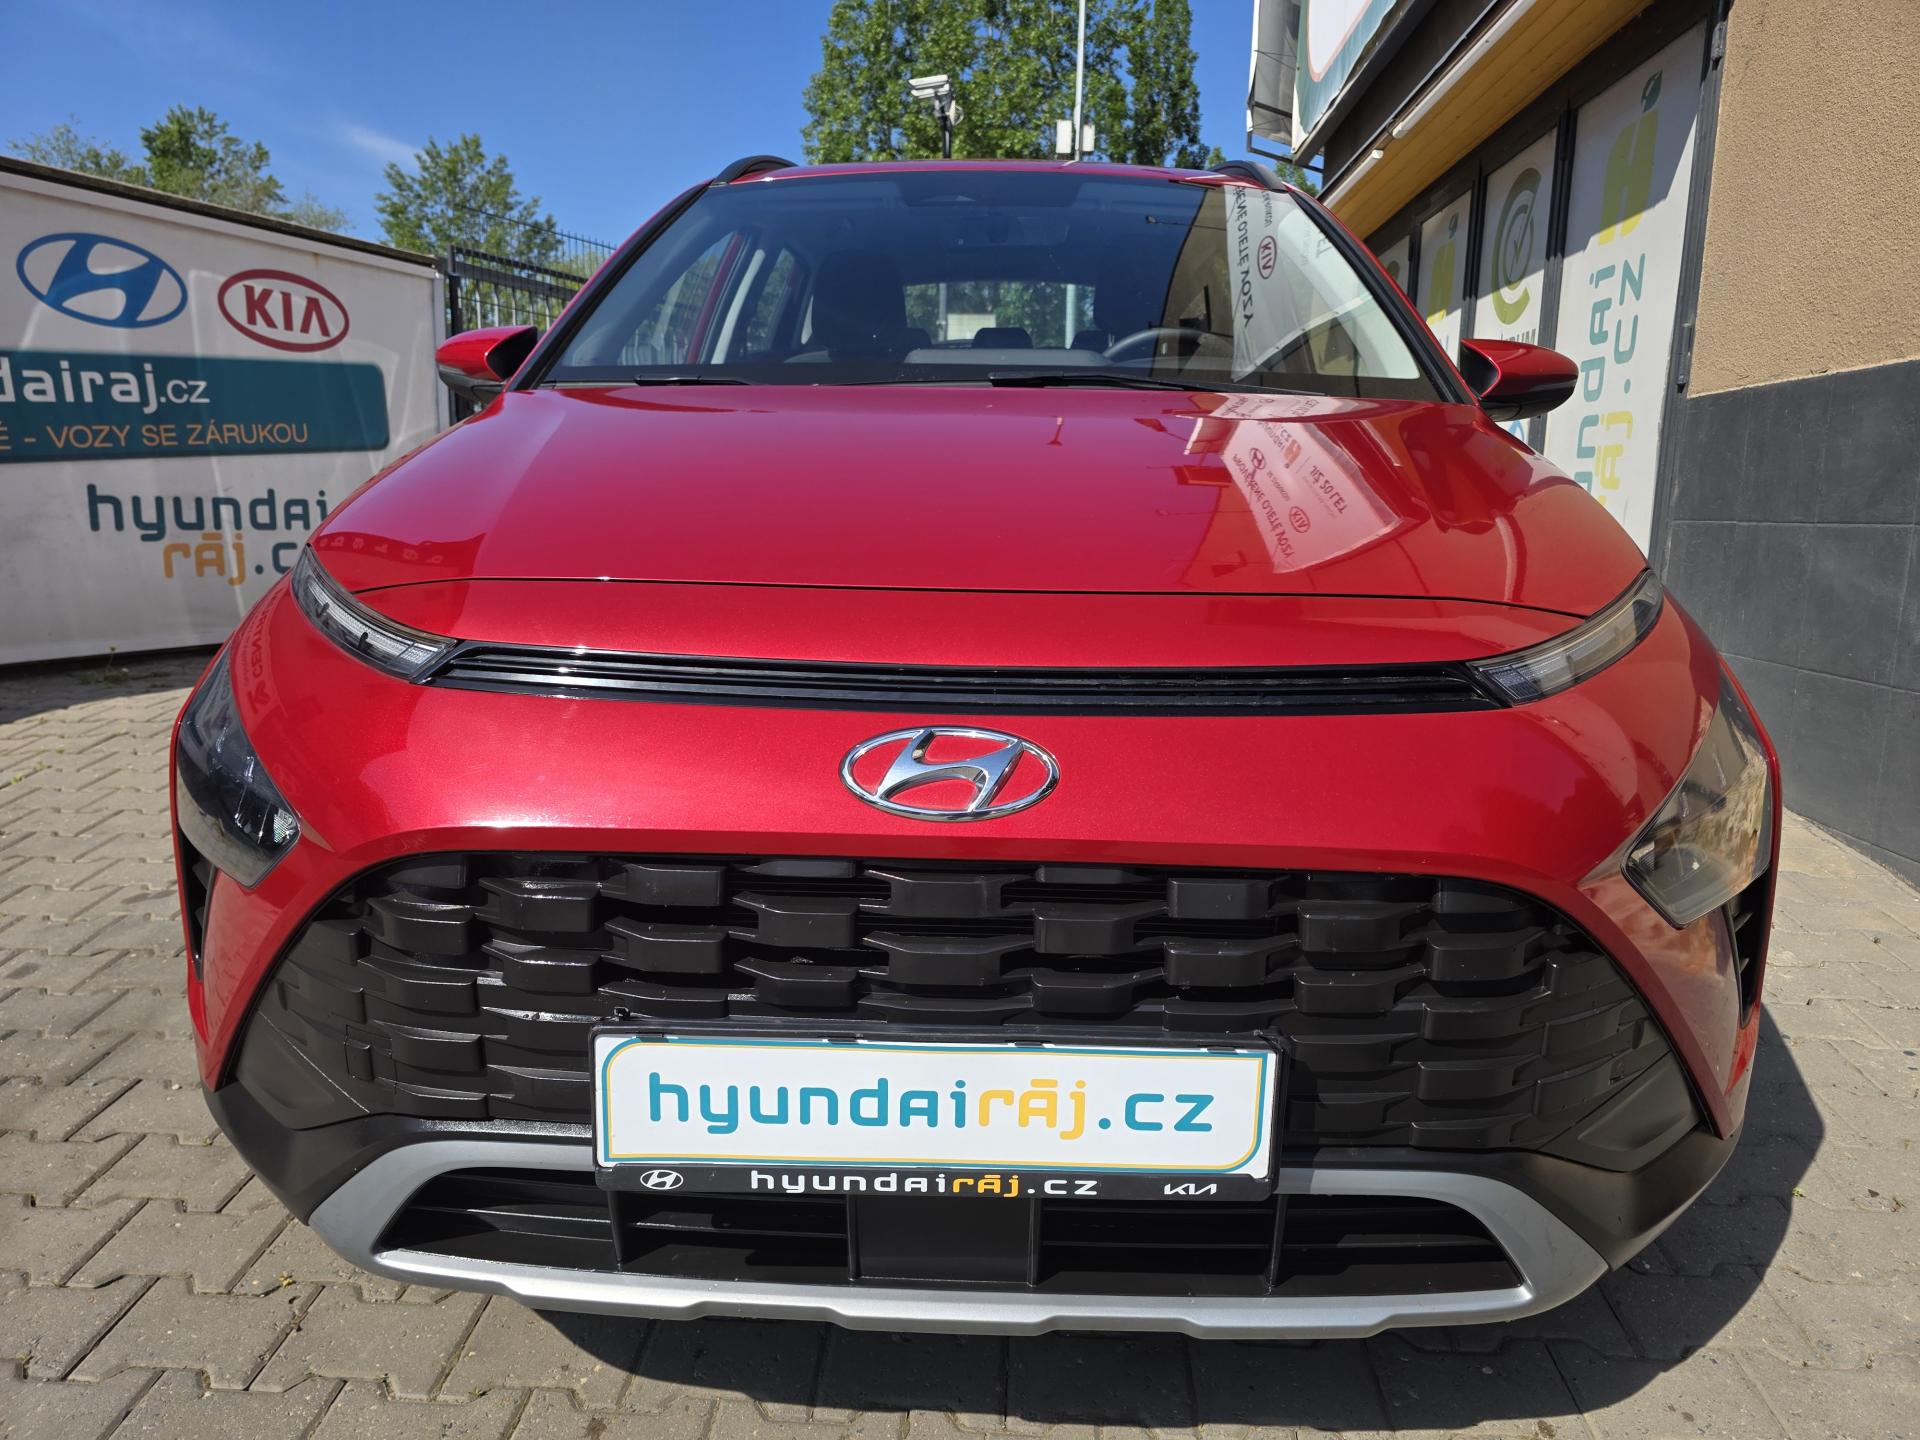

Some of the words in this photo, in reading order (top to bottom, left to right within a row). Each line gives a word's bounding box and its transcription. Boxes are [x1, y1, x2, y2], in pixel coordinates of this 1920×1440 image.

[242, 284, 330, 337] KIA
[46, 425, 131, 448] VOZY
[142, 424, 178, 446] SE
[186, 419, 309, 445] ZÁRUKOU
